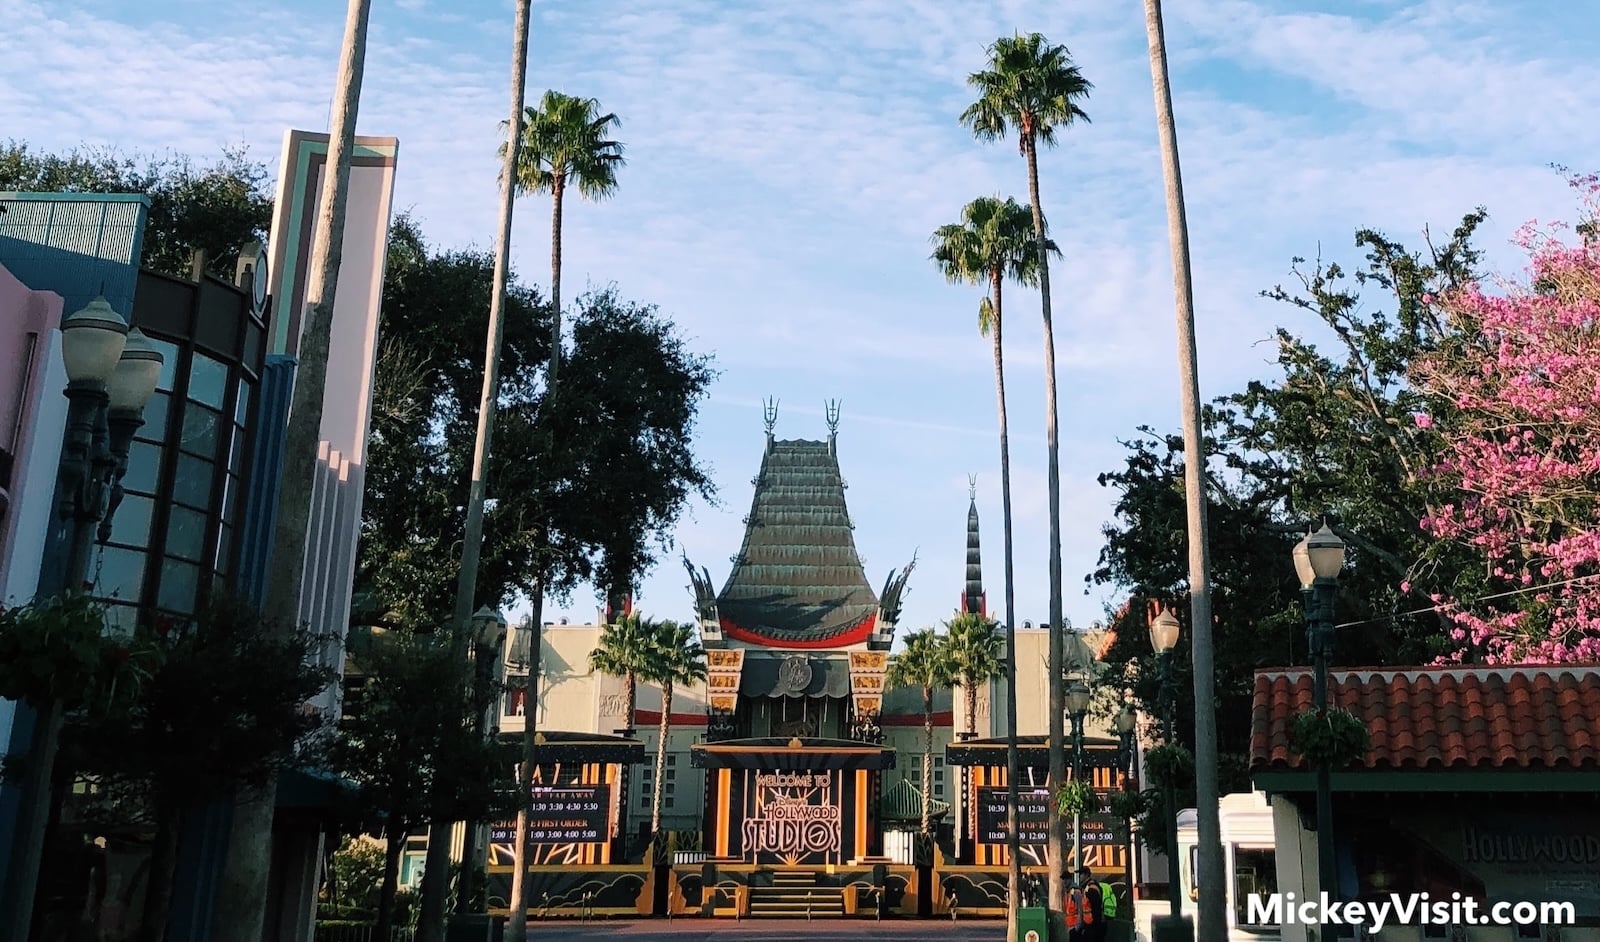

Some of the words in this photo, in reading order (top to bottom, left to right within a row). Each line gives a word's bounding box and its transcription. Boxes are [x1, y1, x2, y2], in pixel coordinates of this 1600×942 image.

[755, 774, 812, 788] WELCOME
[814, 774, 831, 788] TO
[549, 803, 564, 811] 3:30
[566, 803, 581, 811] 4:30
[584, 803, 599, 811] 5:30
[763, 802, 839, 820] HOLLYWOOD
[988, 805, 1006, 813] 10:30
[548, 830, 562, 839] 3:00
[564, 830, 579, 839] 4:00
[582, 830, 597, 839] 5:00
[741, 818, 841, 852] STUDIOS
[989, 831, 1006, 840] 10:00
[1029, 832, 1047, 840] 12:00
[1082, 832, 1097, 840] 4:00
[1099, 832, 1114, 840] 5:00
[1461, 824, 1600, 862] HOLLYWOOD
